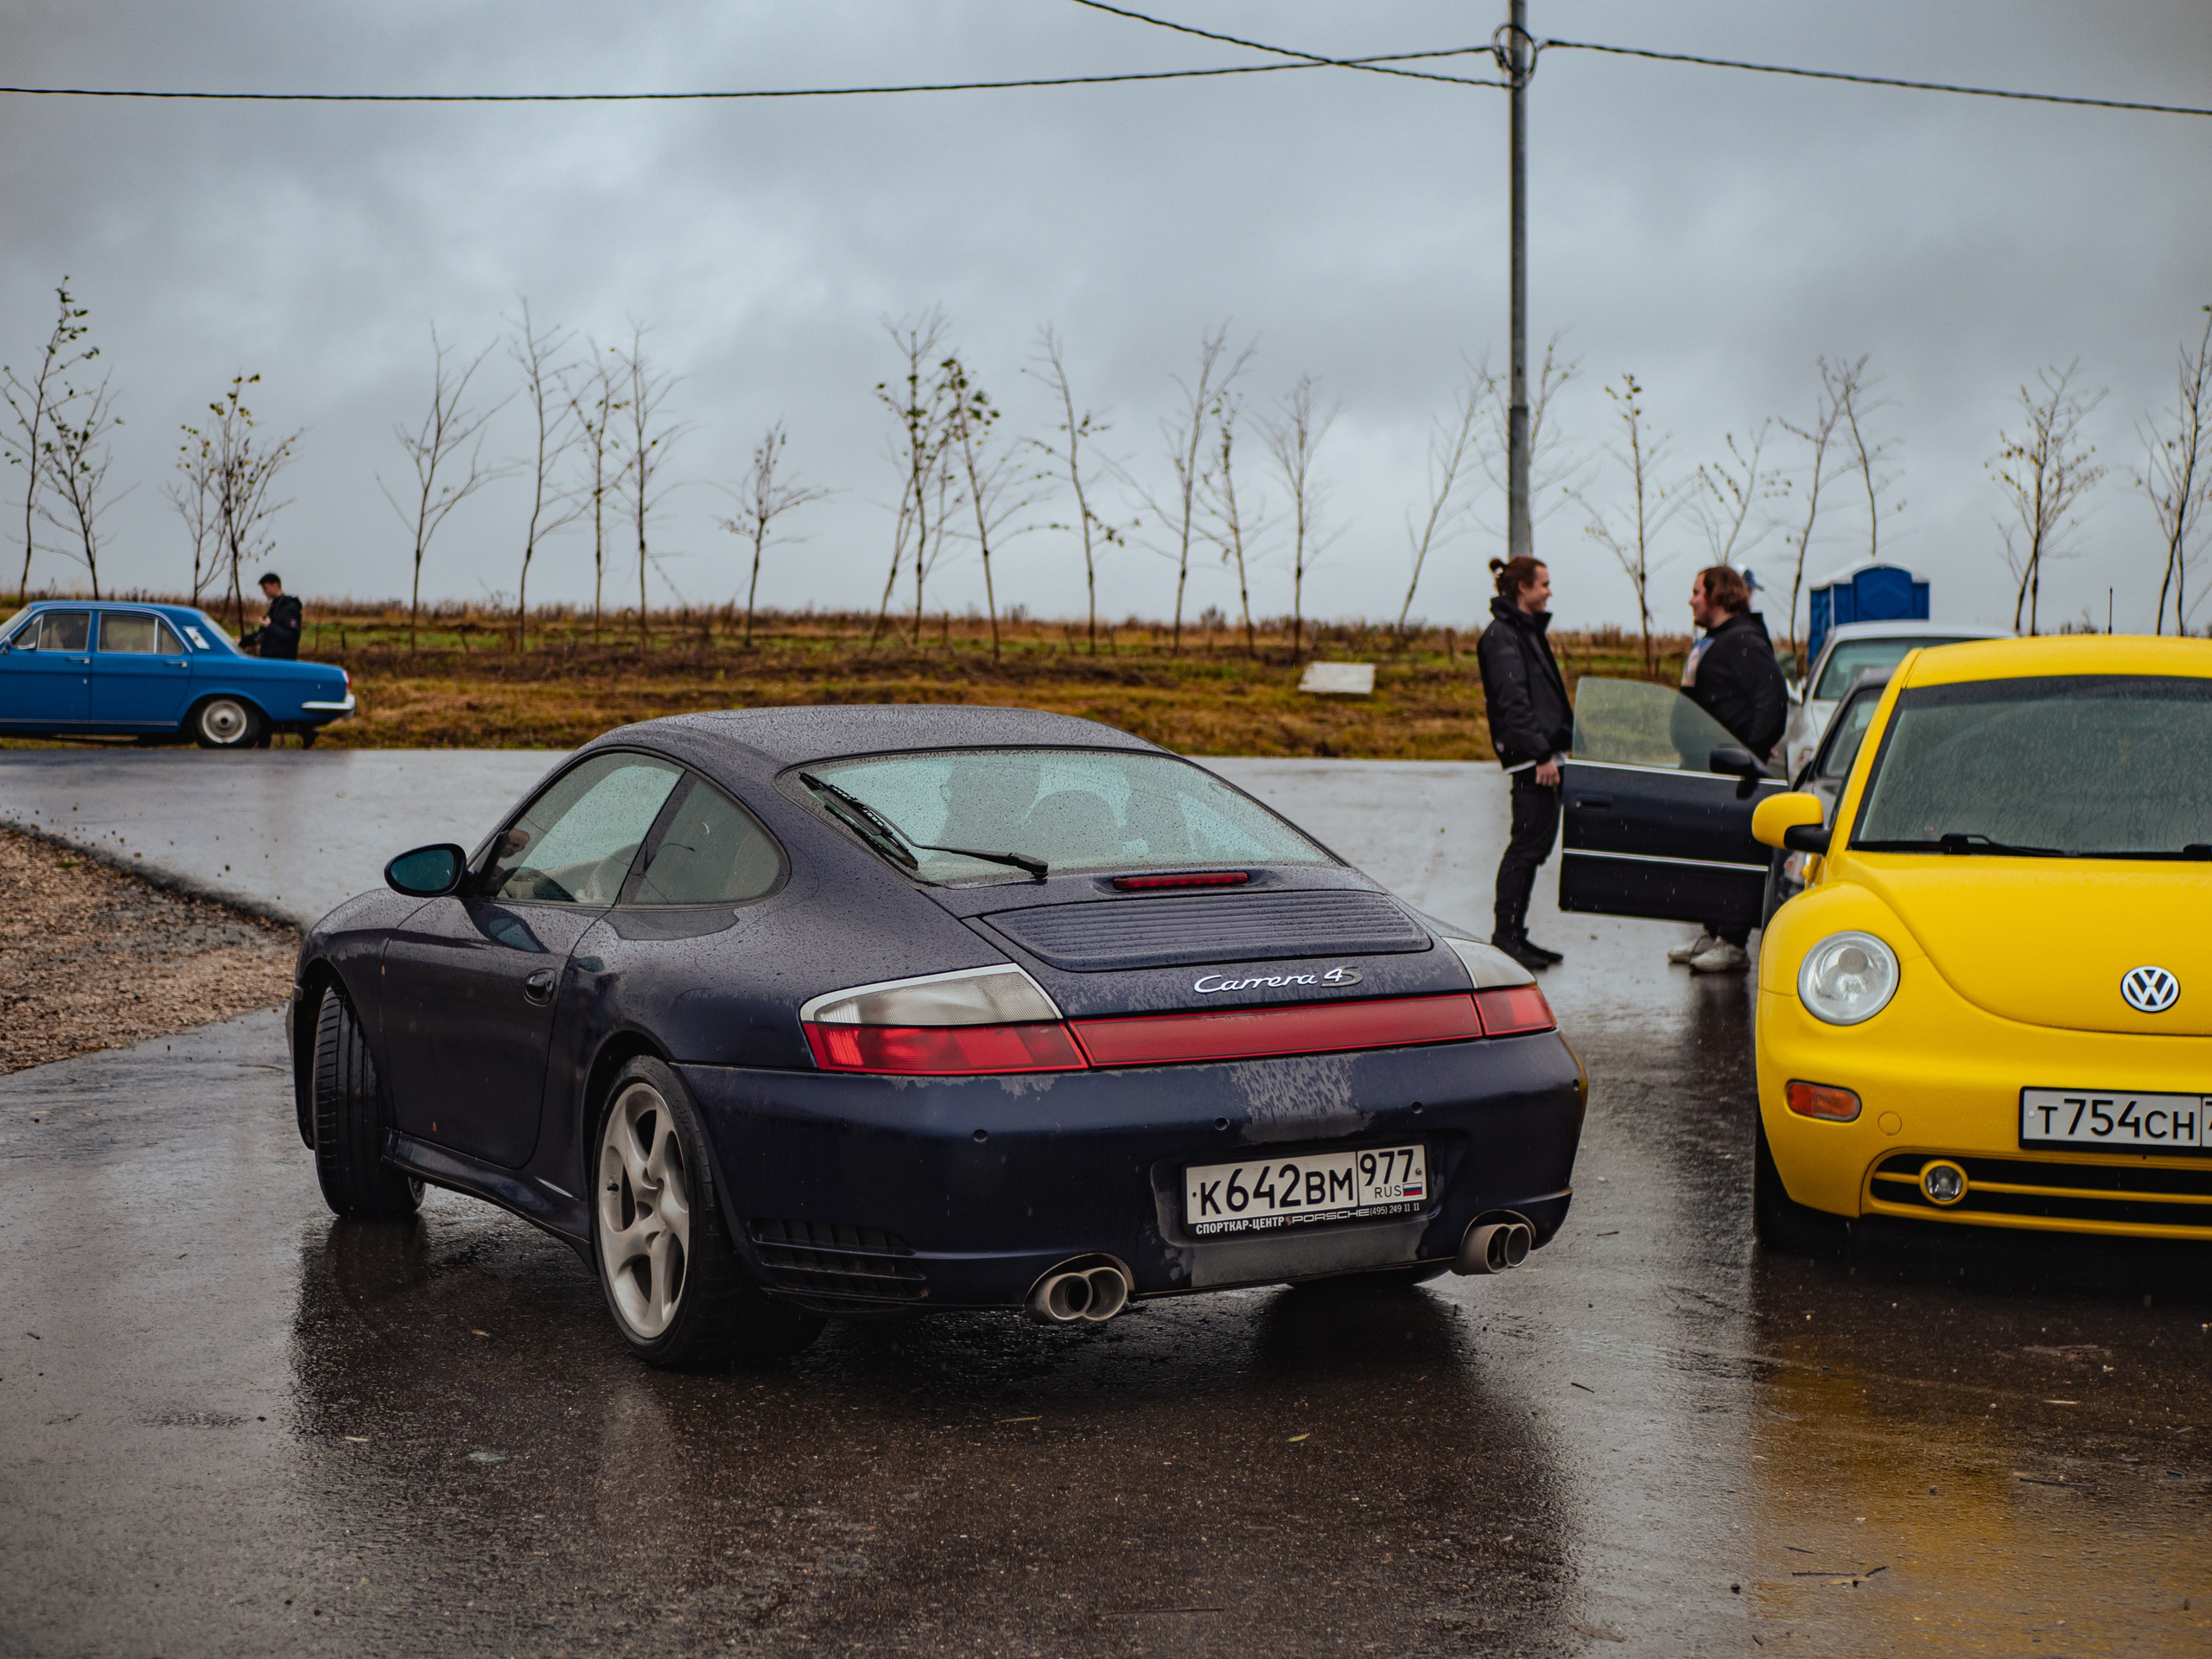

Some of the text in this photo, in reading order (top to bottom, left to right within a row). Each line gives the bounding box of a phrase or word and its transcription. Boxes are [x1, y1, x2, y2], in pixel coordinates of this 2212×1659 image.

[1193, 964, 1363, 994] Carrera 4S
[1359, 1148, 1414, 1187] 977
[1374, 1185, 1402, 1199] RUS
[1195, 1202, 1420, 1235] СПОРТКАР-ЦЕНТР PORSCHE (495) 249 11 11
